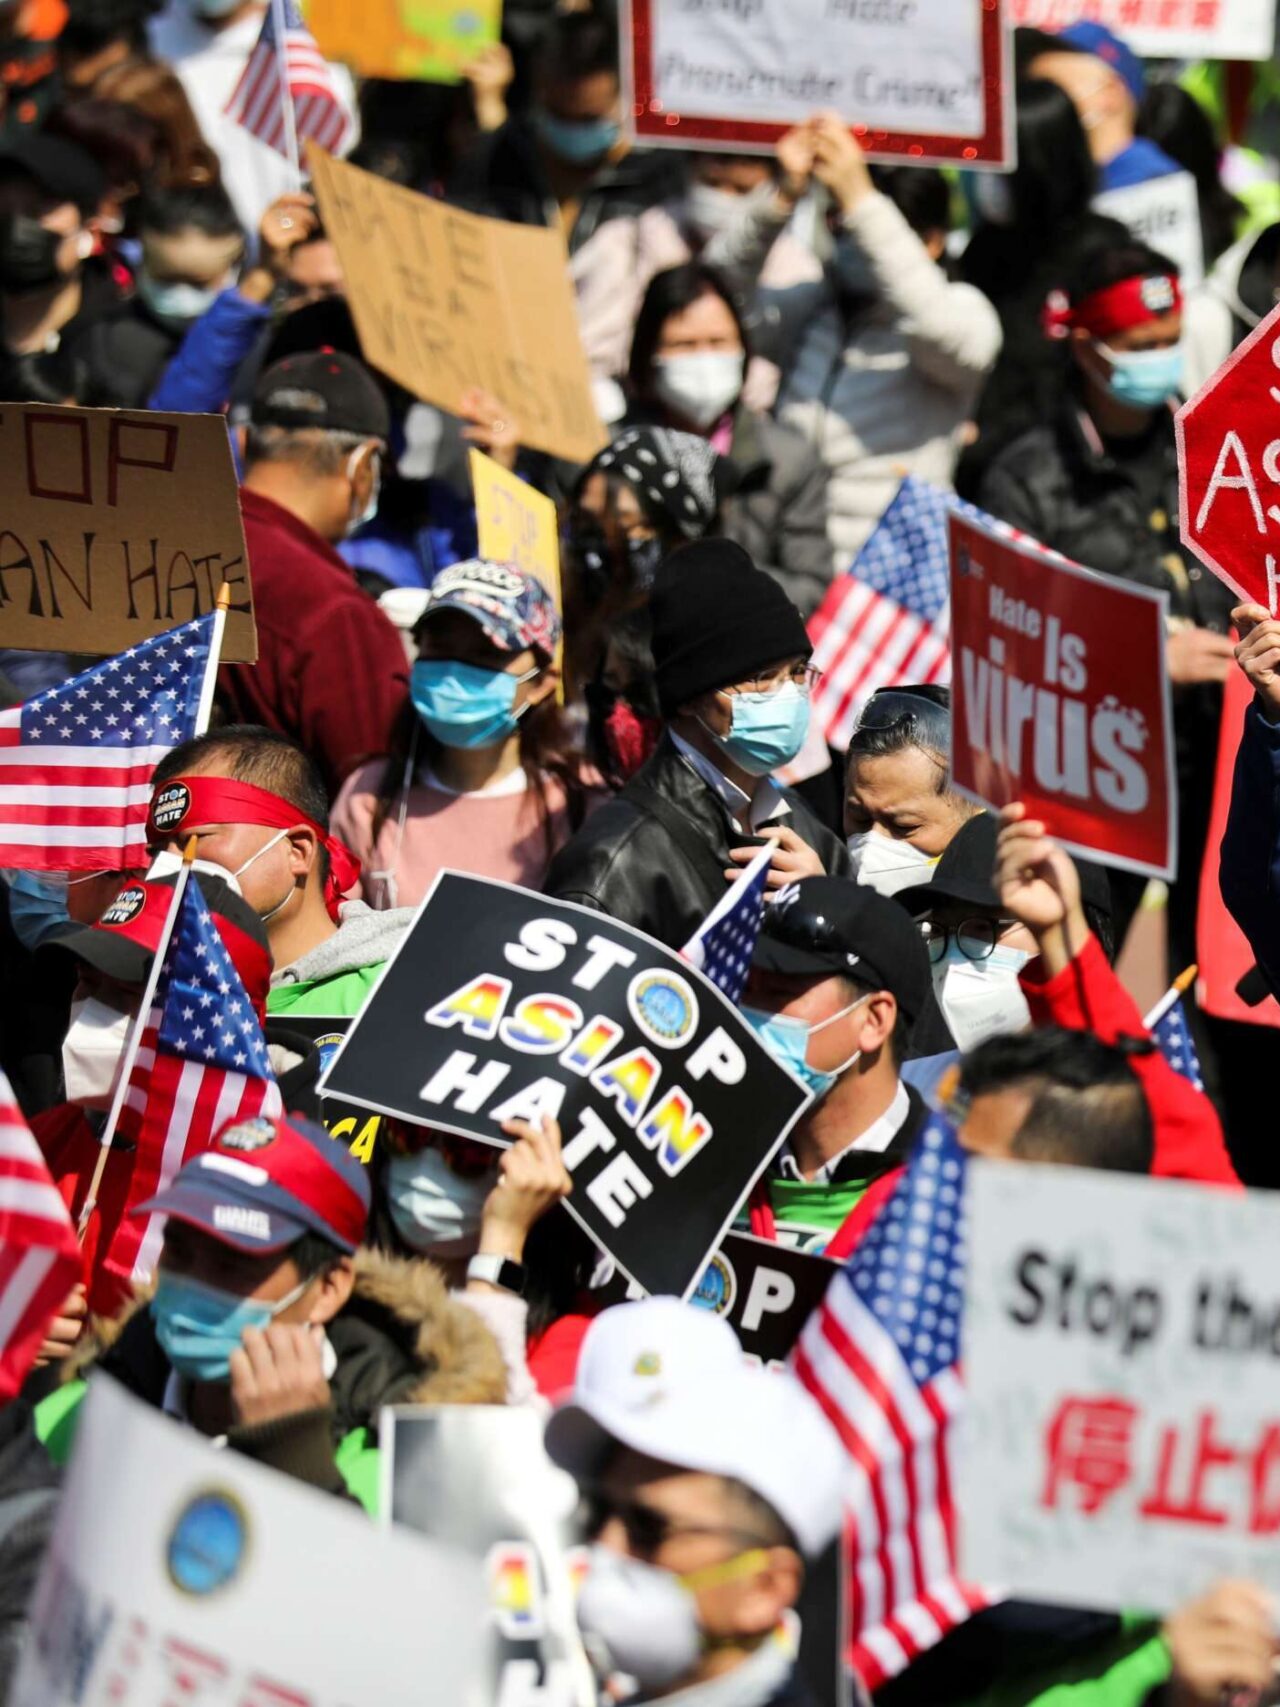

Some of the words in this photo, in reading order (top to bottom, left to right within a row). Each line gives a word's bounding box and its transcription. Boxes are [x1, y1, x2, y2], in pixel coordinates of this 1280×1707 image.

[22, 412, 178, 507] OP
[121, 538, 251, 620] HATE
[989, 584, 1042, 639] Hate
[1043, 616, 1087, 691] Is
[962, 635, 1150, 814] virus
[504, 917, 746, 1086] STOP
[419, 1050, 654, 1228] HATE
[424, 973, 713, 1178] ASIAN
[1007, 1250, 1162, 1356] Stop
